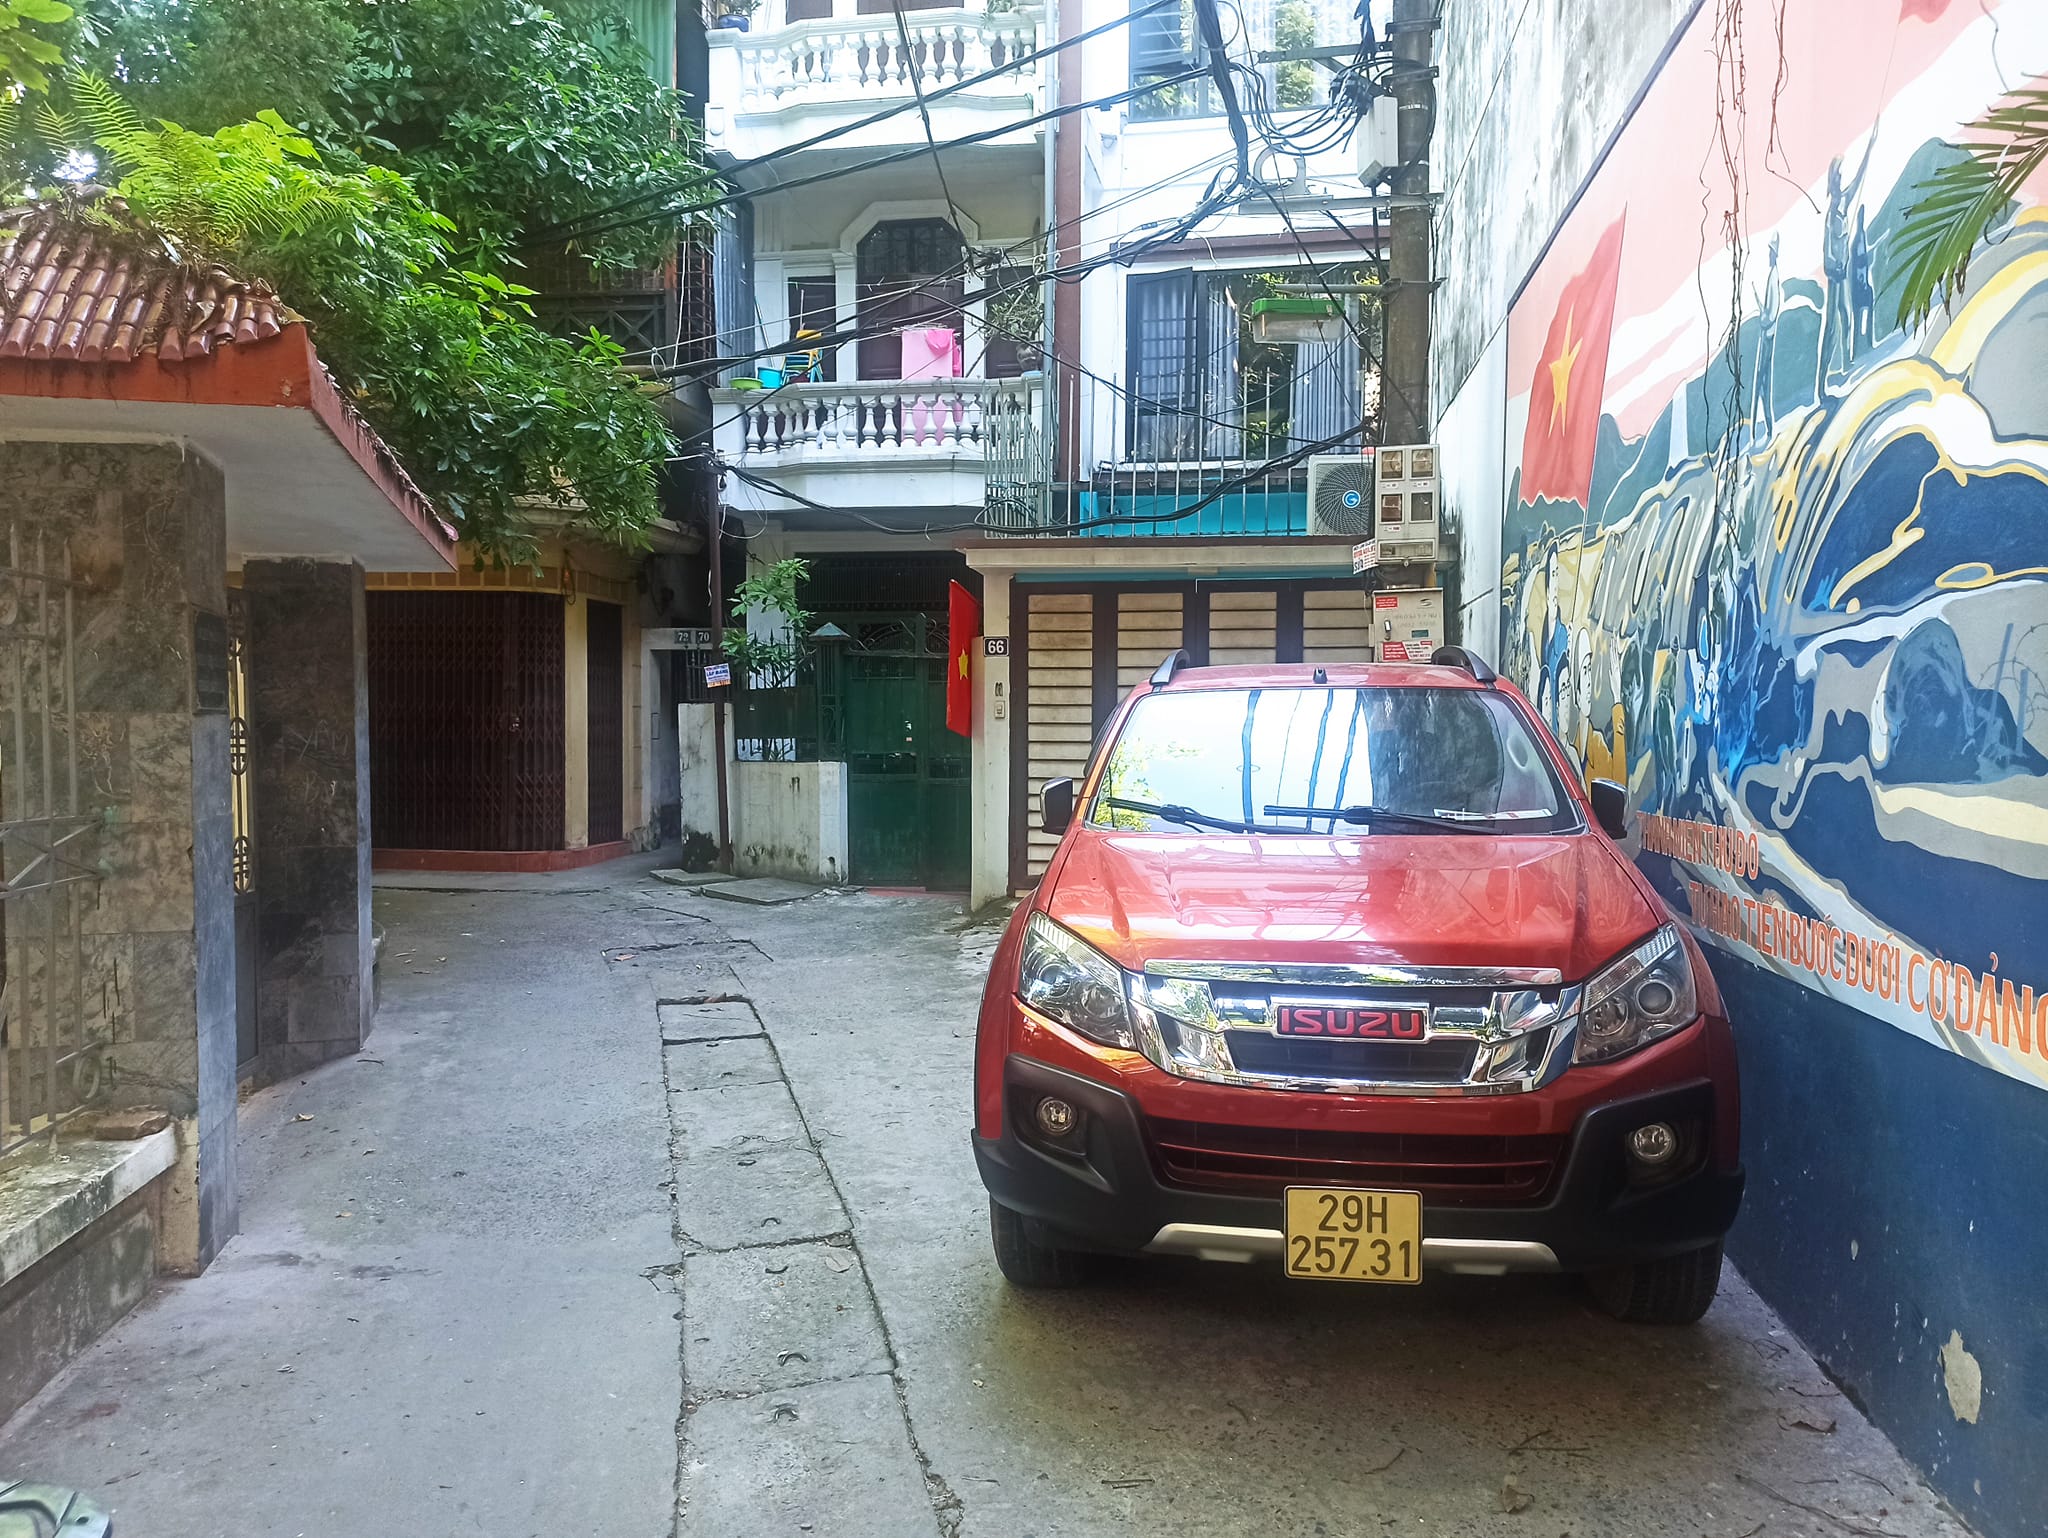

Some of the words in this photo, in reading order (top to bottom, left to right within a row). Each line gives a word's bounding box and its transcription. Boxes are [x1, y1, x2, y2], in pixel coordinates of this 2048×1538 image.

[678, 632, 689, 642] 72
[698, 632, 710, 642] 70
[988, 640, 1004, 654] 66
[1280, 1008, 1423, 1038] ISUZU
[1318, 1194, 1388, 1234] 29H
[1291, 1235, 1412, 1278] 257.31
